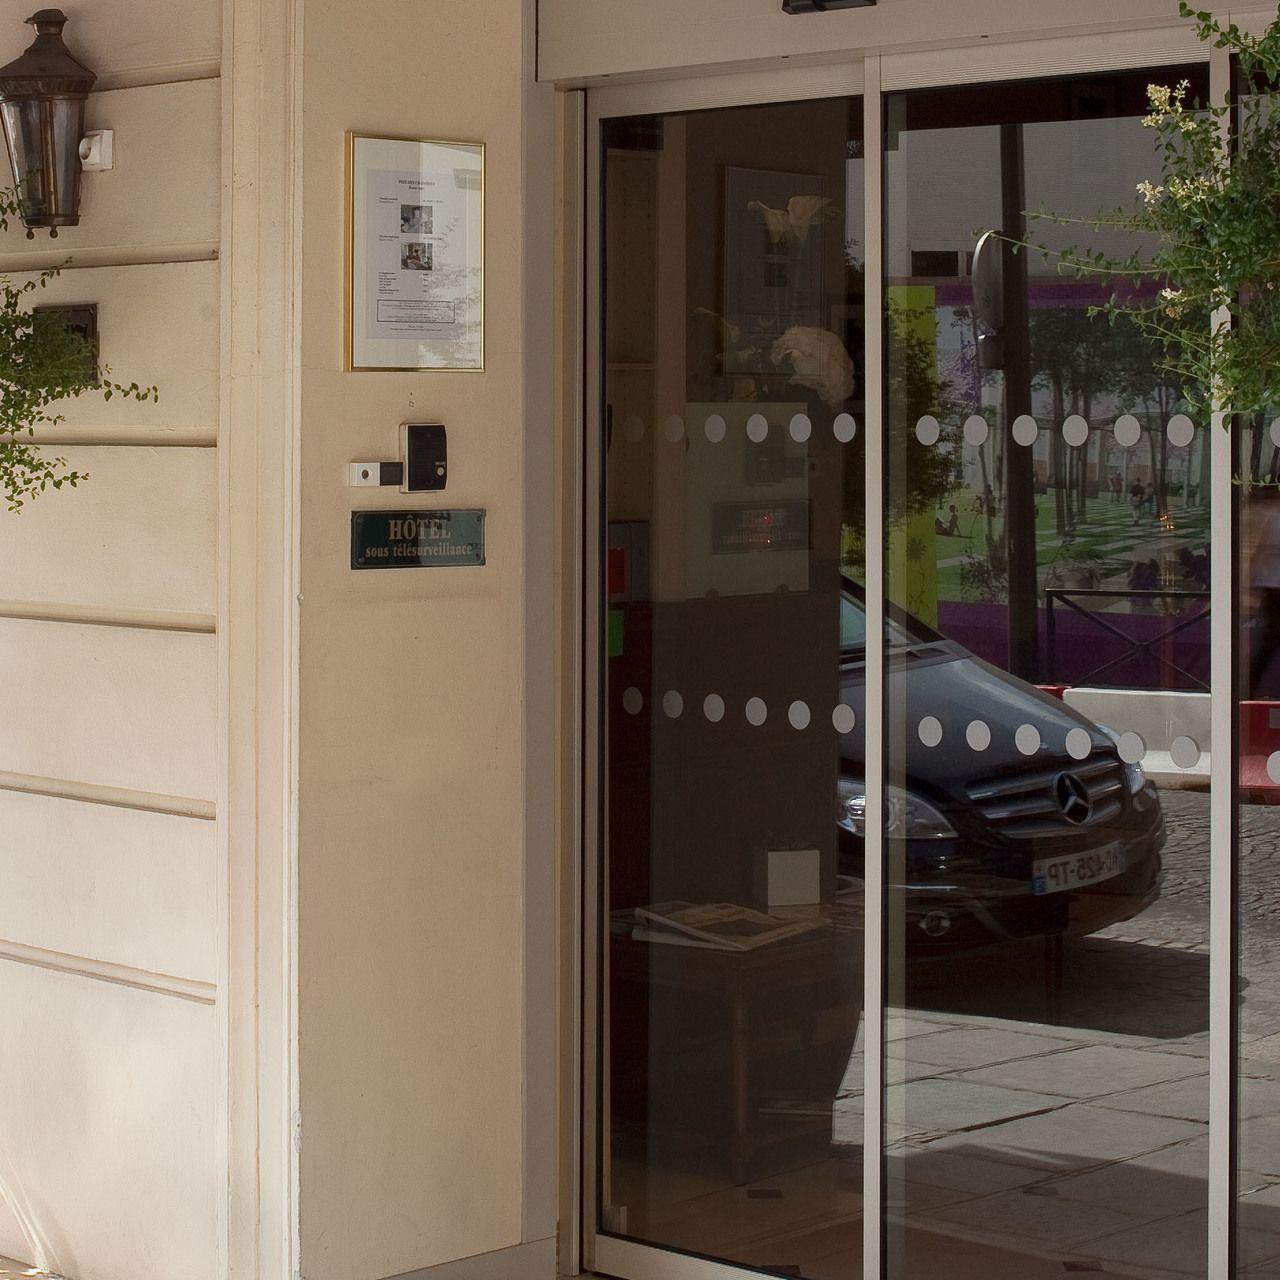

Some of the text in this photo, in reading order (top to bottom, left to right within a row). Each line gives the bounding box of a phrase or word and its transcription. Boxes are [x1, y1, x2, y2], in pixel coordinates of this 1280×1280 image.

[388, 515, 451, 540] HÔTEL
[365, 542, 473, 558] sous télésurveillance
